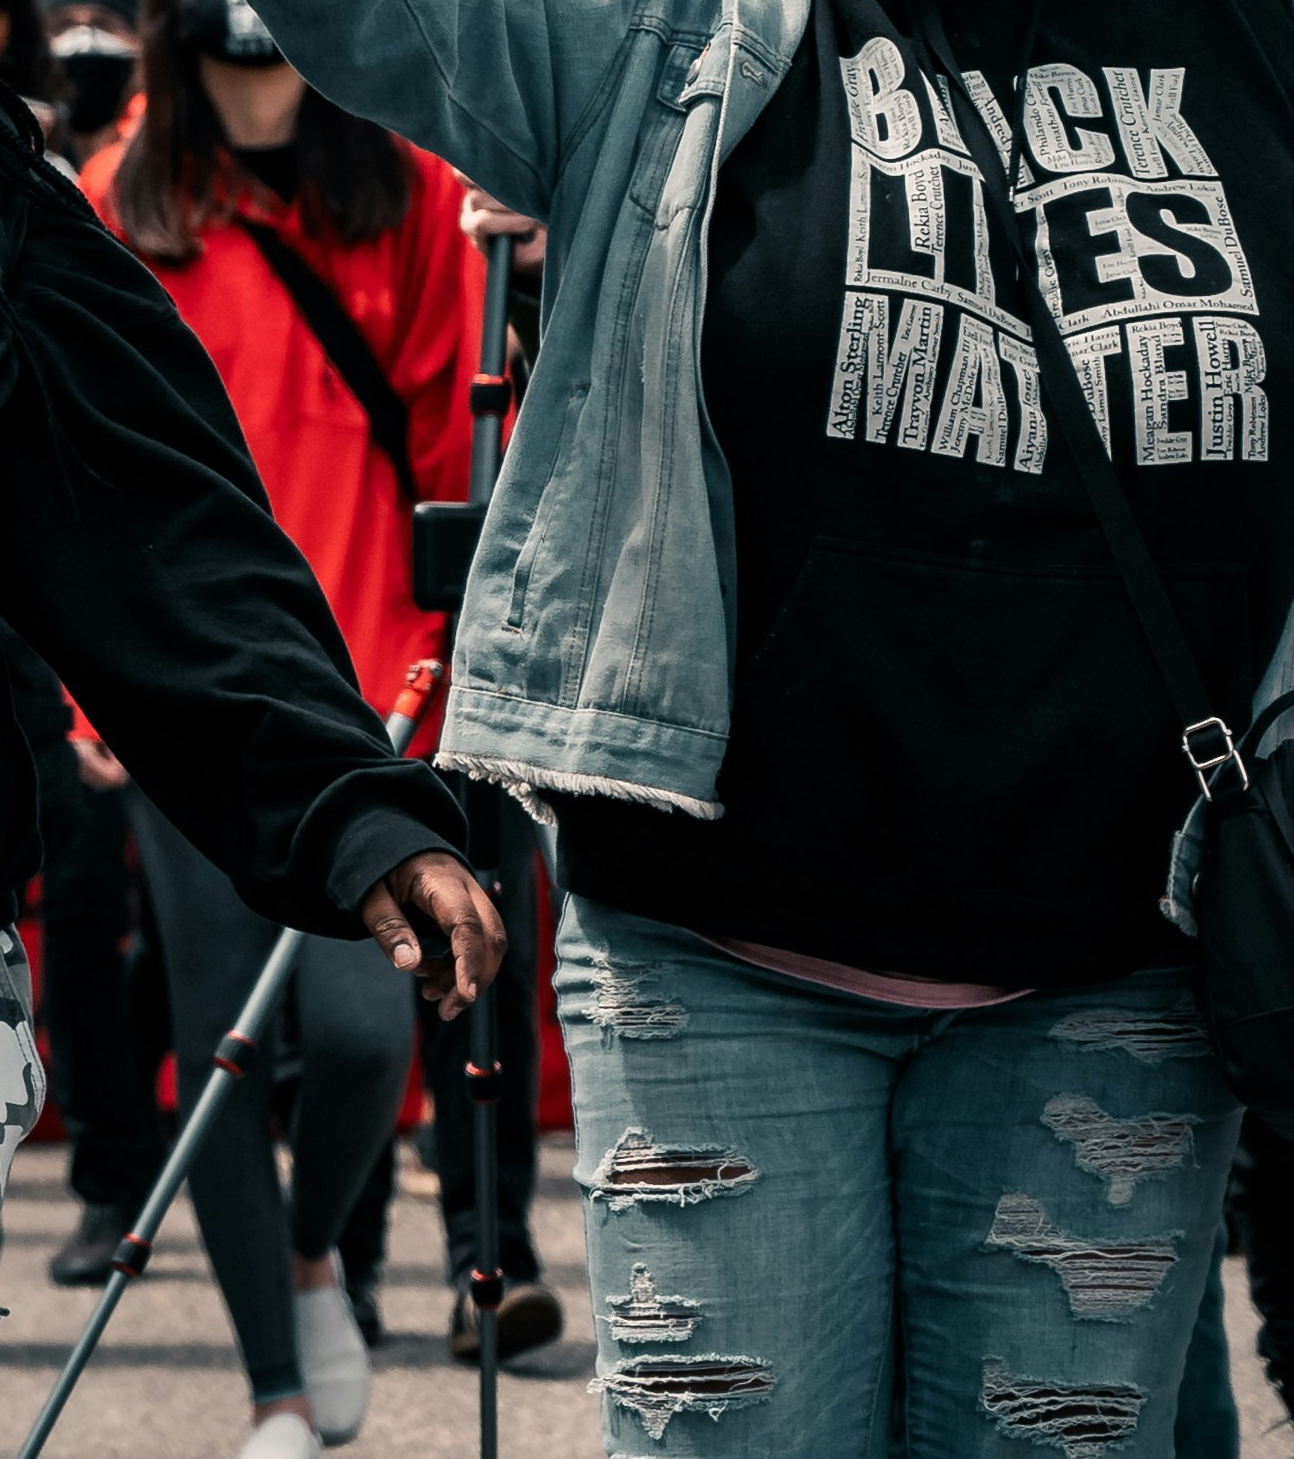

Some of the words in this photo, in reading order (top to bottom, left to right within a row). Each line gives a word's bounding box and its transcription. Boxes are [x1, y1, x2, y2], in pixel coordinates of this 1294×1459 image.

[1132, 129, 1151, 177] Terence
[913, 205, 931, 251] Rekia
[1215, 195, 1238, 249] DuBose
[1227, 250, 1254, 298] Samuel
[911, 305, 933, 368] Martin
[1102, 299, 1160, 319] Abdullahi
[1199, 298, 1255, 312] Mohamed
[1090, 340, 1120, 353] Clark
[1135, 334, 1156, 404] Hockaday
[1198, 319, 1223, 391] Howell
[831, 379, 855, 437] Alton
[901, 372, 927, 445] Trayvon
[1155, 377, 1169, 430] Sandra
[1205, 395, 1229, 460] Justin
[1018, 409, 1040, 471] Aiyana
[1142, 404, 1160, 463] Meagan
